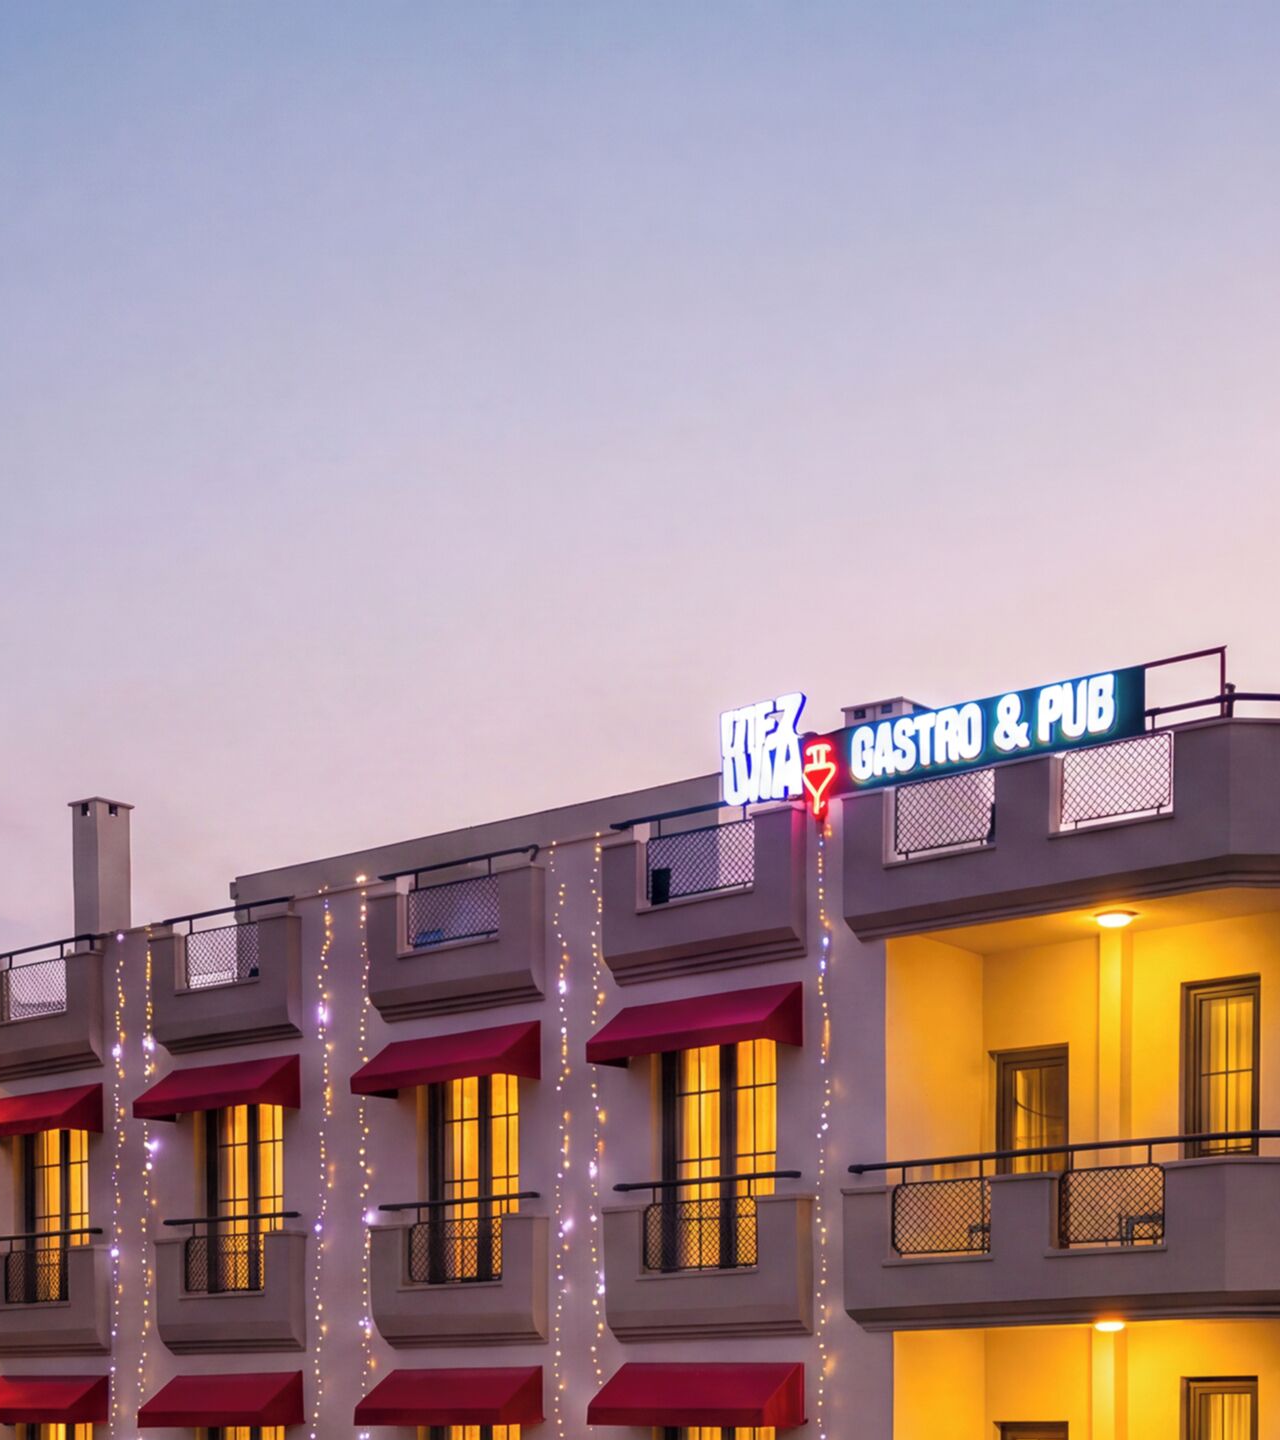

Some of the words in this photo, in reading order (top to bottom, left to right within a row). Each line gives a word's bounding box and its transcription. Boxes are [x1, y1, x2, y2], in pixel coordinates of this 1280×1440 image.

[850, 702, 983, 781] GASTRO
[993, 693, 1031, 752] &
[1036, 672, 1115, 741] PUB
